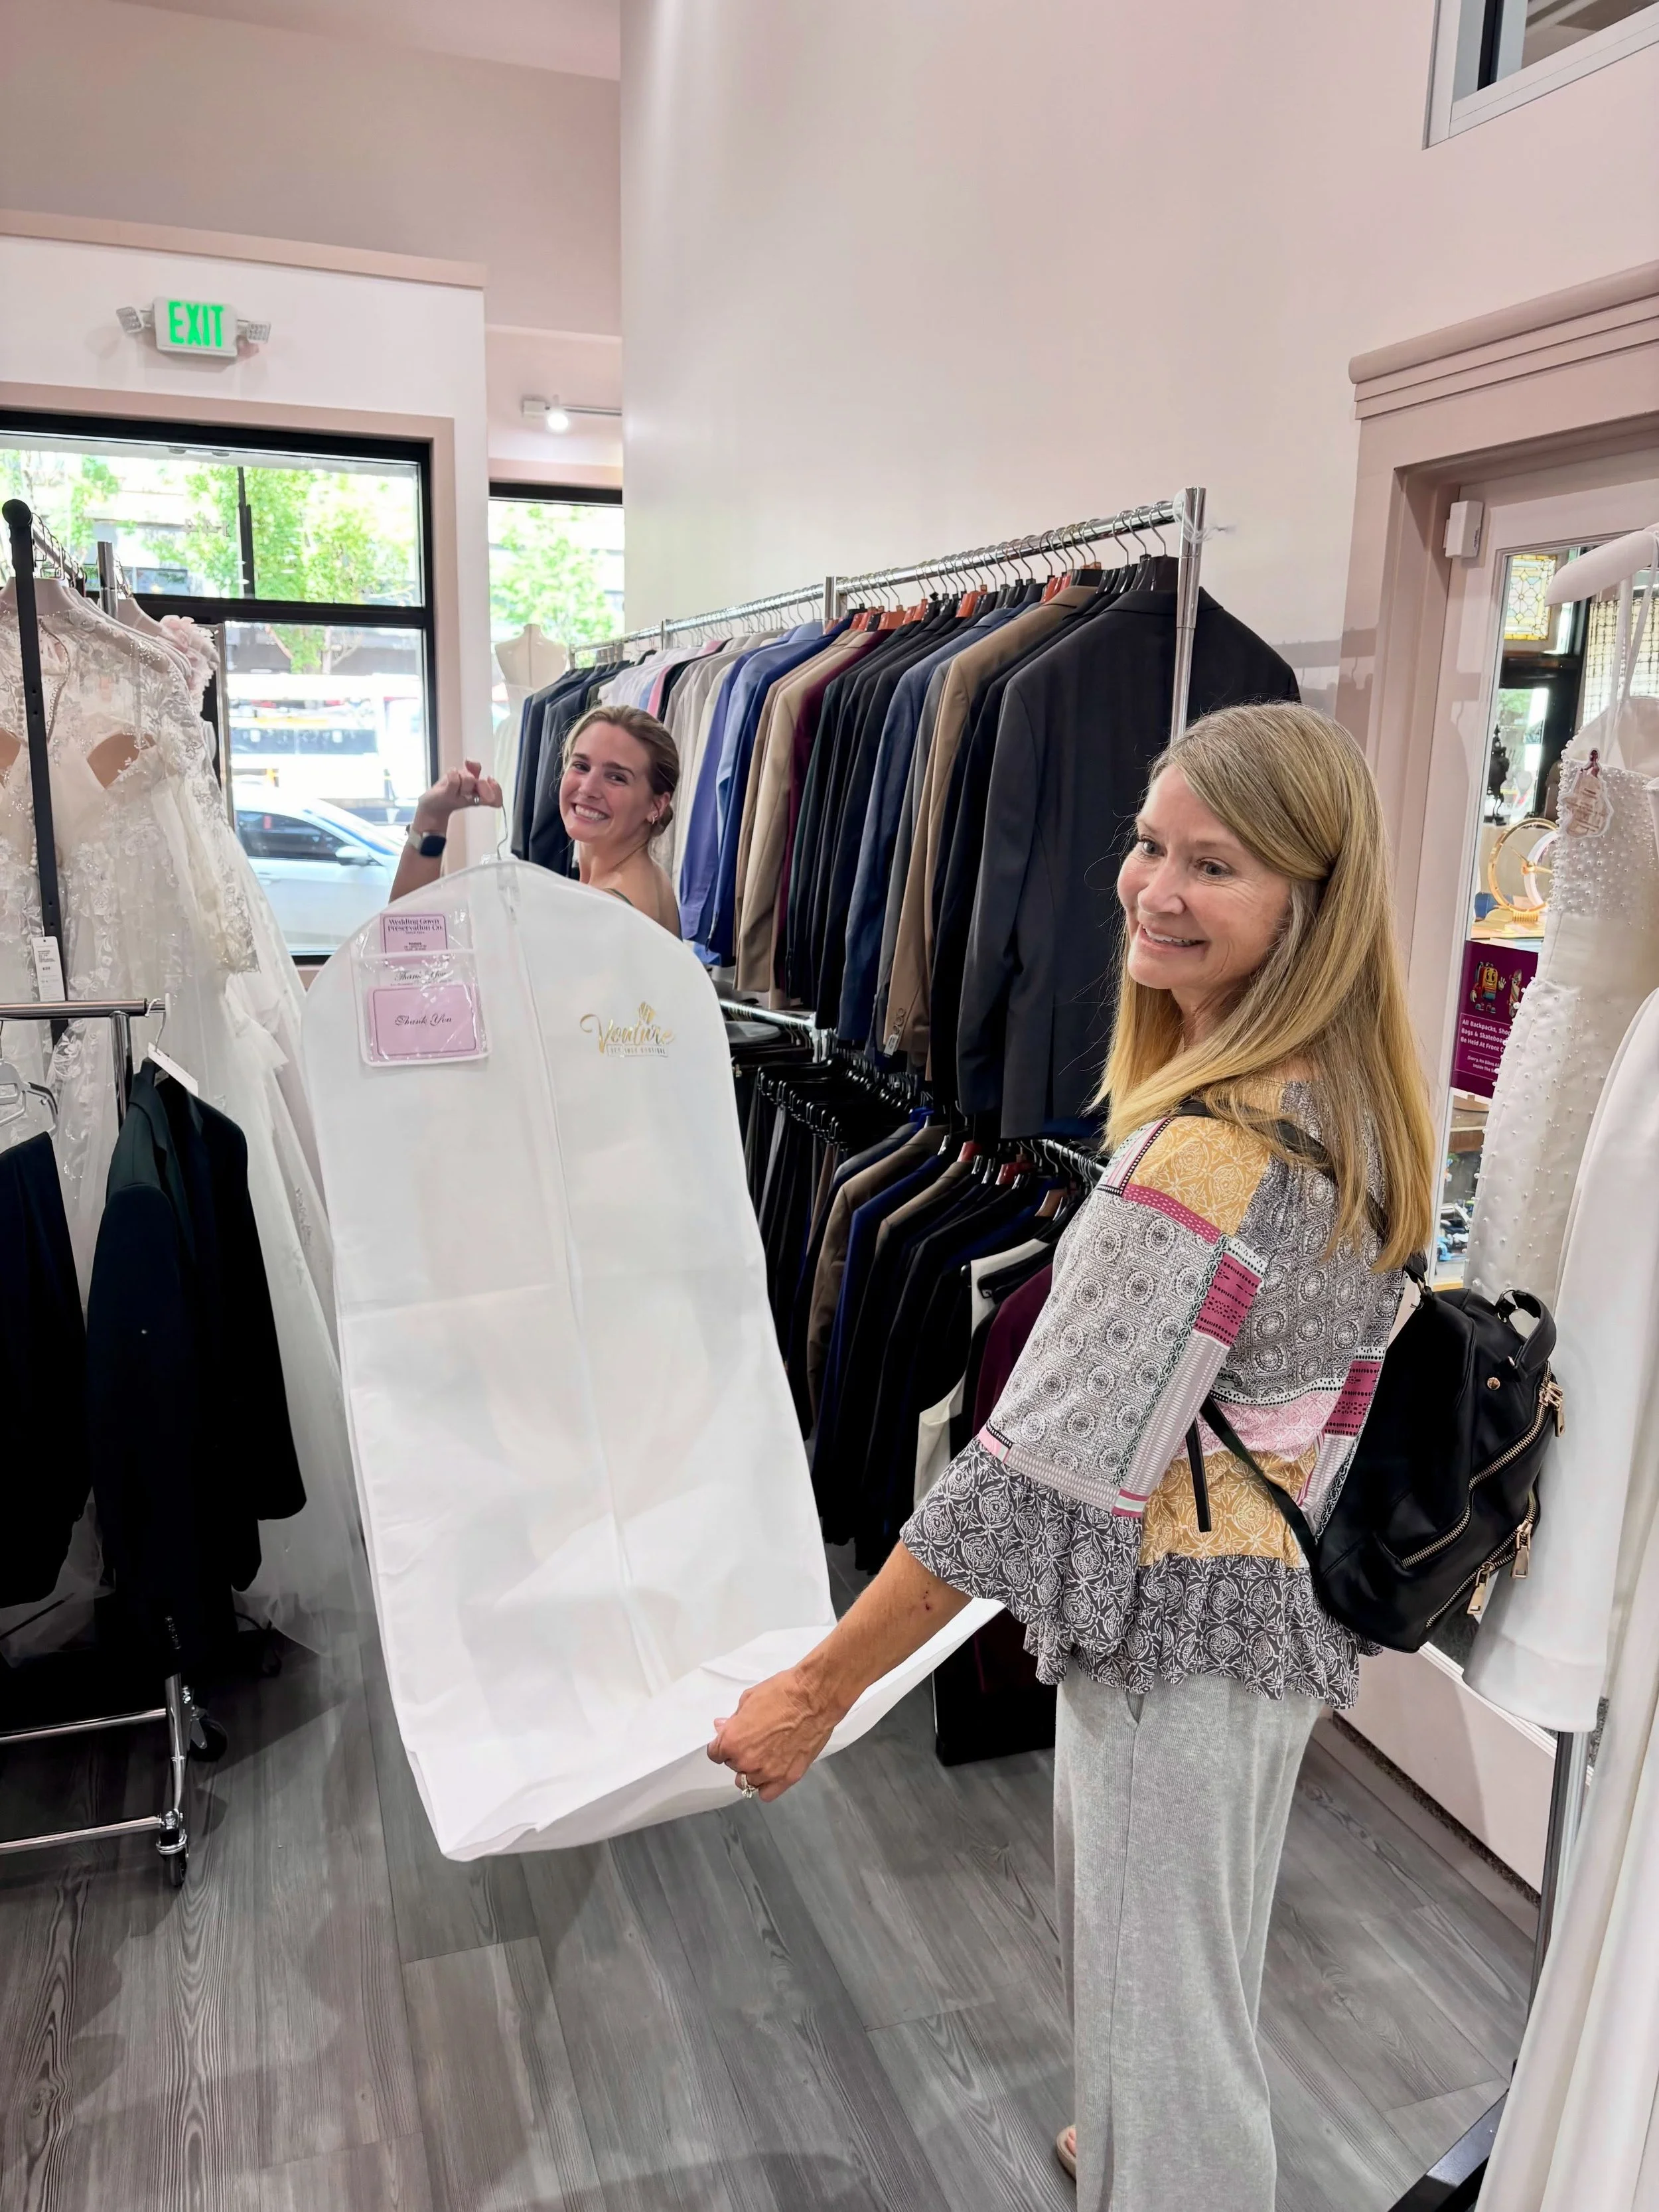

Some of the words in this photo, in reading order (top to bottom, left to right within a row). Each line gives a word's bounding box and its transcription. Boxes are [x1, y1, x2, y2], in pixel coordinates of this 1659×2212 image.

[168, 301, 224, 347] EXIT
[395, 1015, 427, 1026] Thank
[430, 1012, 452, 1027] You
[1461, 1027, 1473, 1036] Bags
[1470, 1021, 1497, 1033] Backpacks,
[1486, 1043, 1500, 1051] Front
